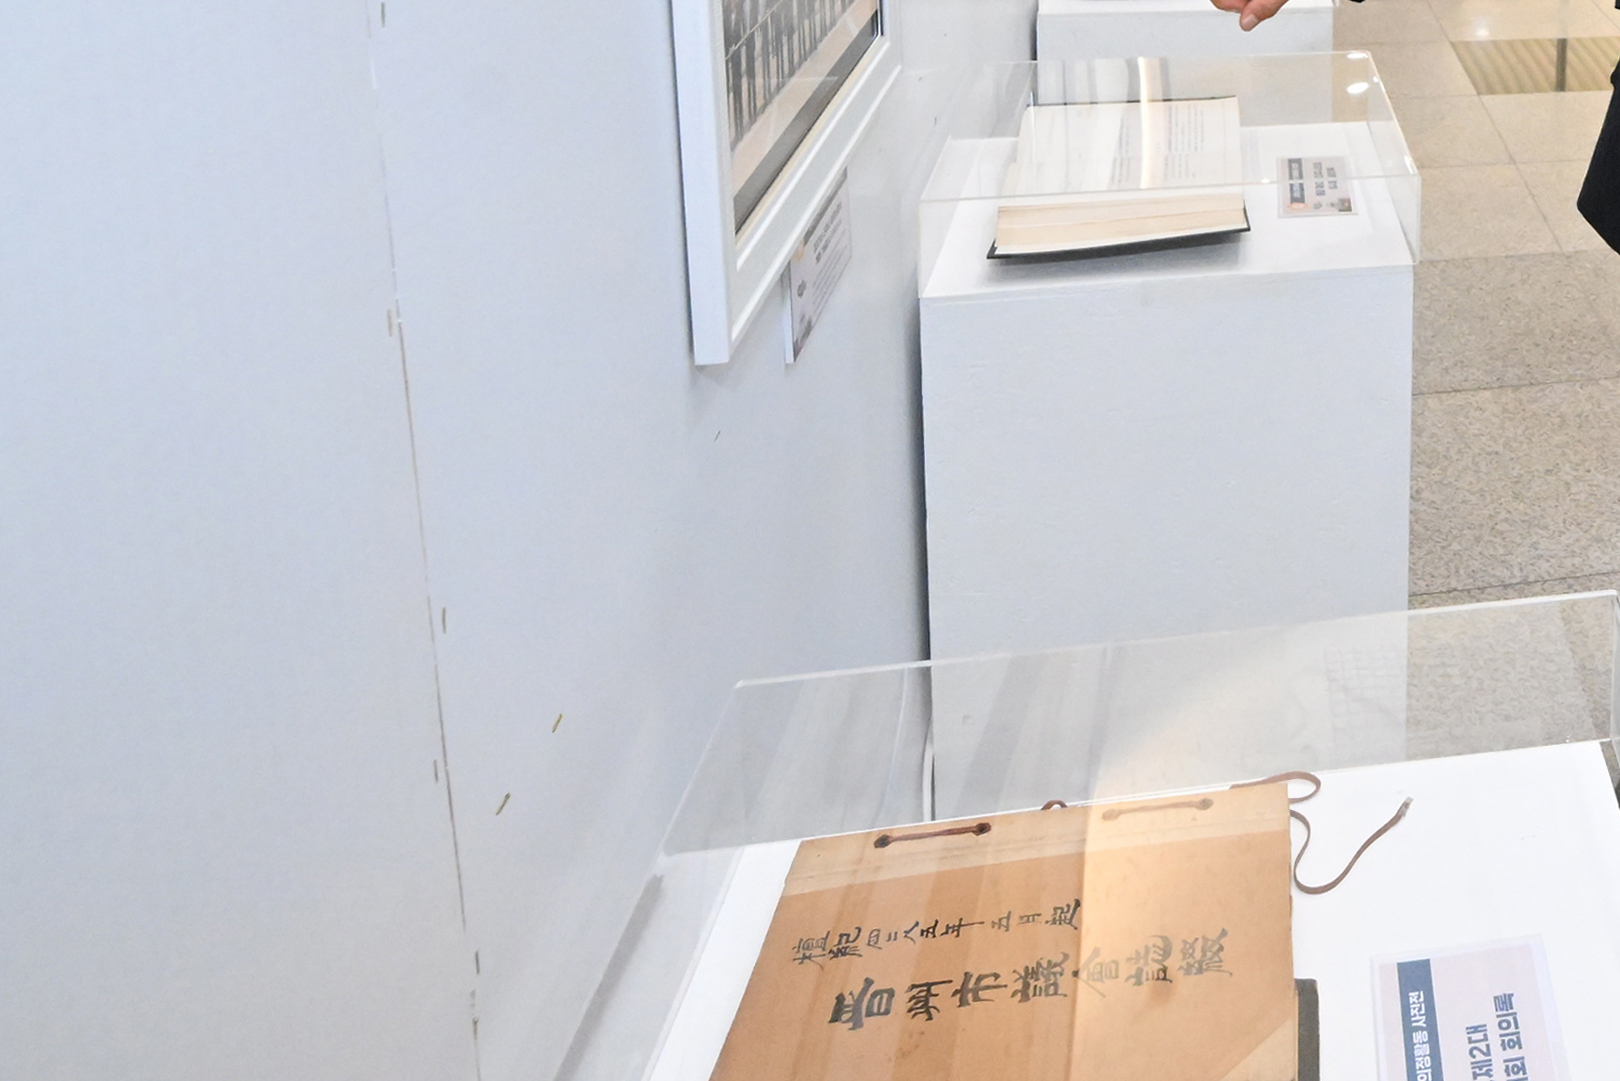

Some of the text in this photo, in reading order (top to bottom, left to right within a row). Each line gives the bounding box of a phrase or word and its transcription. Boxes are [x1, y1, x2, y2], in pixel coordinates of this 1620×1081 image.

[1408, 990, 1426, 1027] 사진전
[1493, 992, 1528, 1081] 회 회의록
